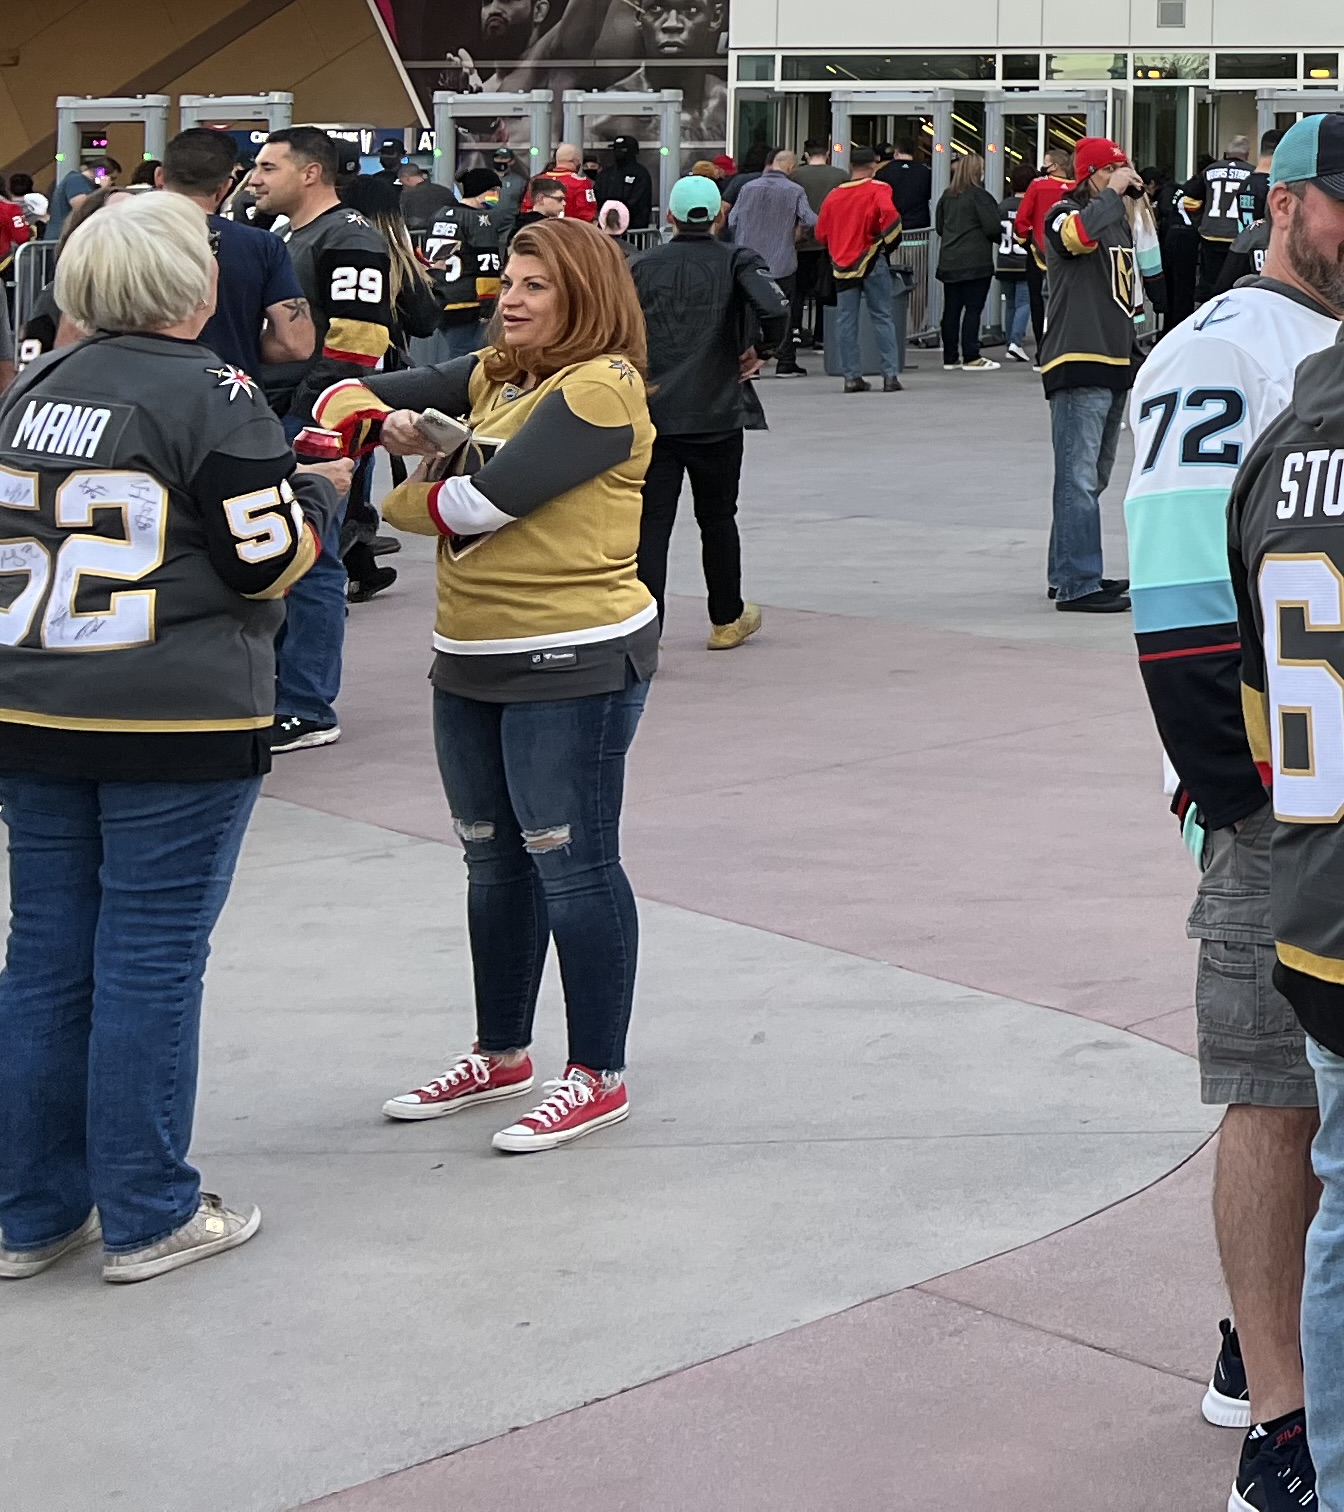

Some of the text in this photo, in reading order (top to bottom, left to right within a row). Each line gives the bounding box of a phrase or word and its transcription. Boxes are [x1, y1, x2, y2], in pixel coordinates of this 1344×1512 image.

[331, 266, 384, 302] 29
[476, 253, 500, 272] 75
[11, 400, 112, 459] MANA
[1139, 386, 1248, 476] 72
[222, 478, 304, 565] 5
